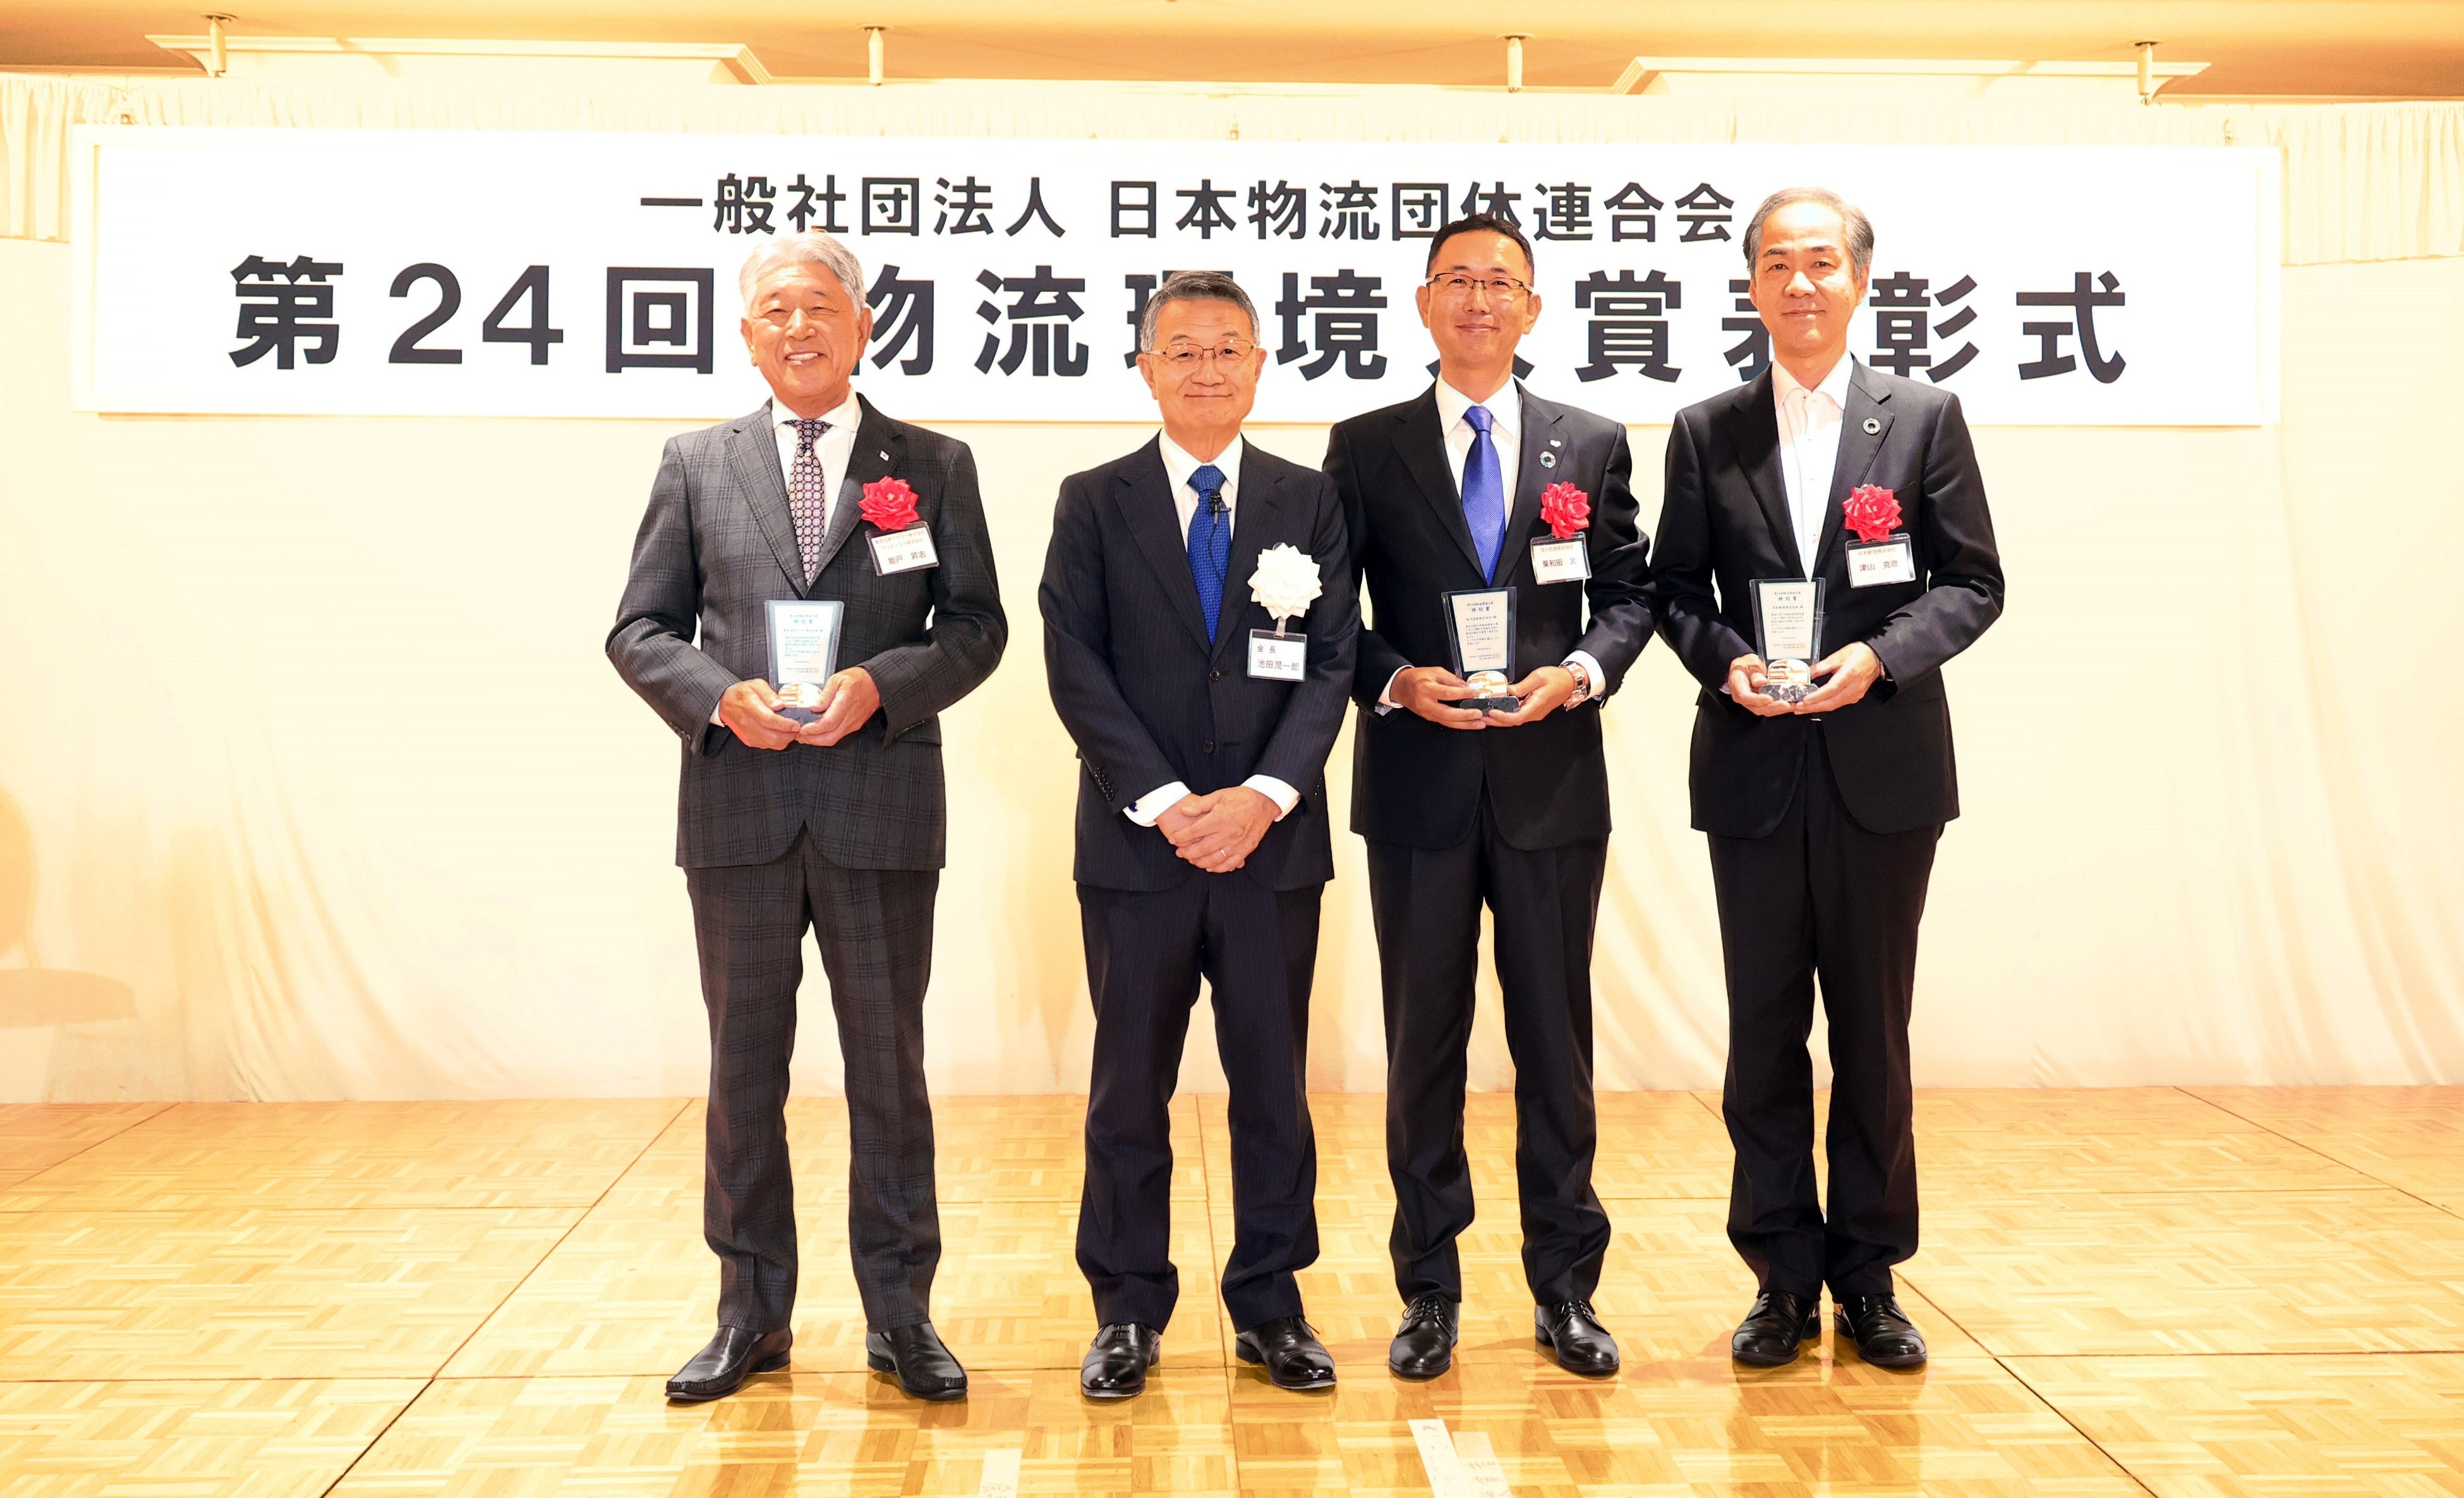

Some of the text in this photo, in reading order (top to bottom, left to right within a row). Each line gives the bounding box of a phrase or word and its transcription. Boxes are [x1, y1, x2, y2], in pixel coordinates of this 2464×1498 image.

[641, 173, 1066, 238] 一般社団法人
